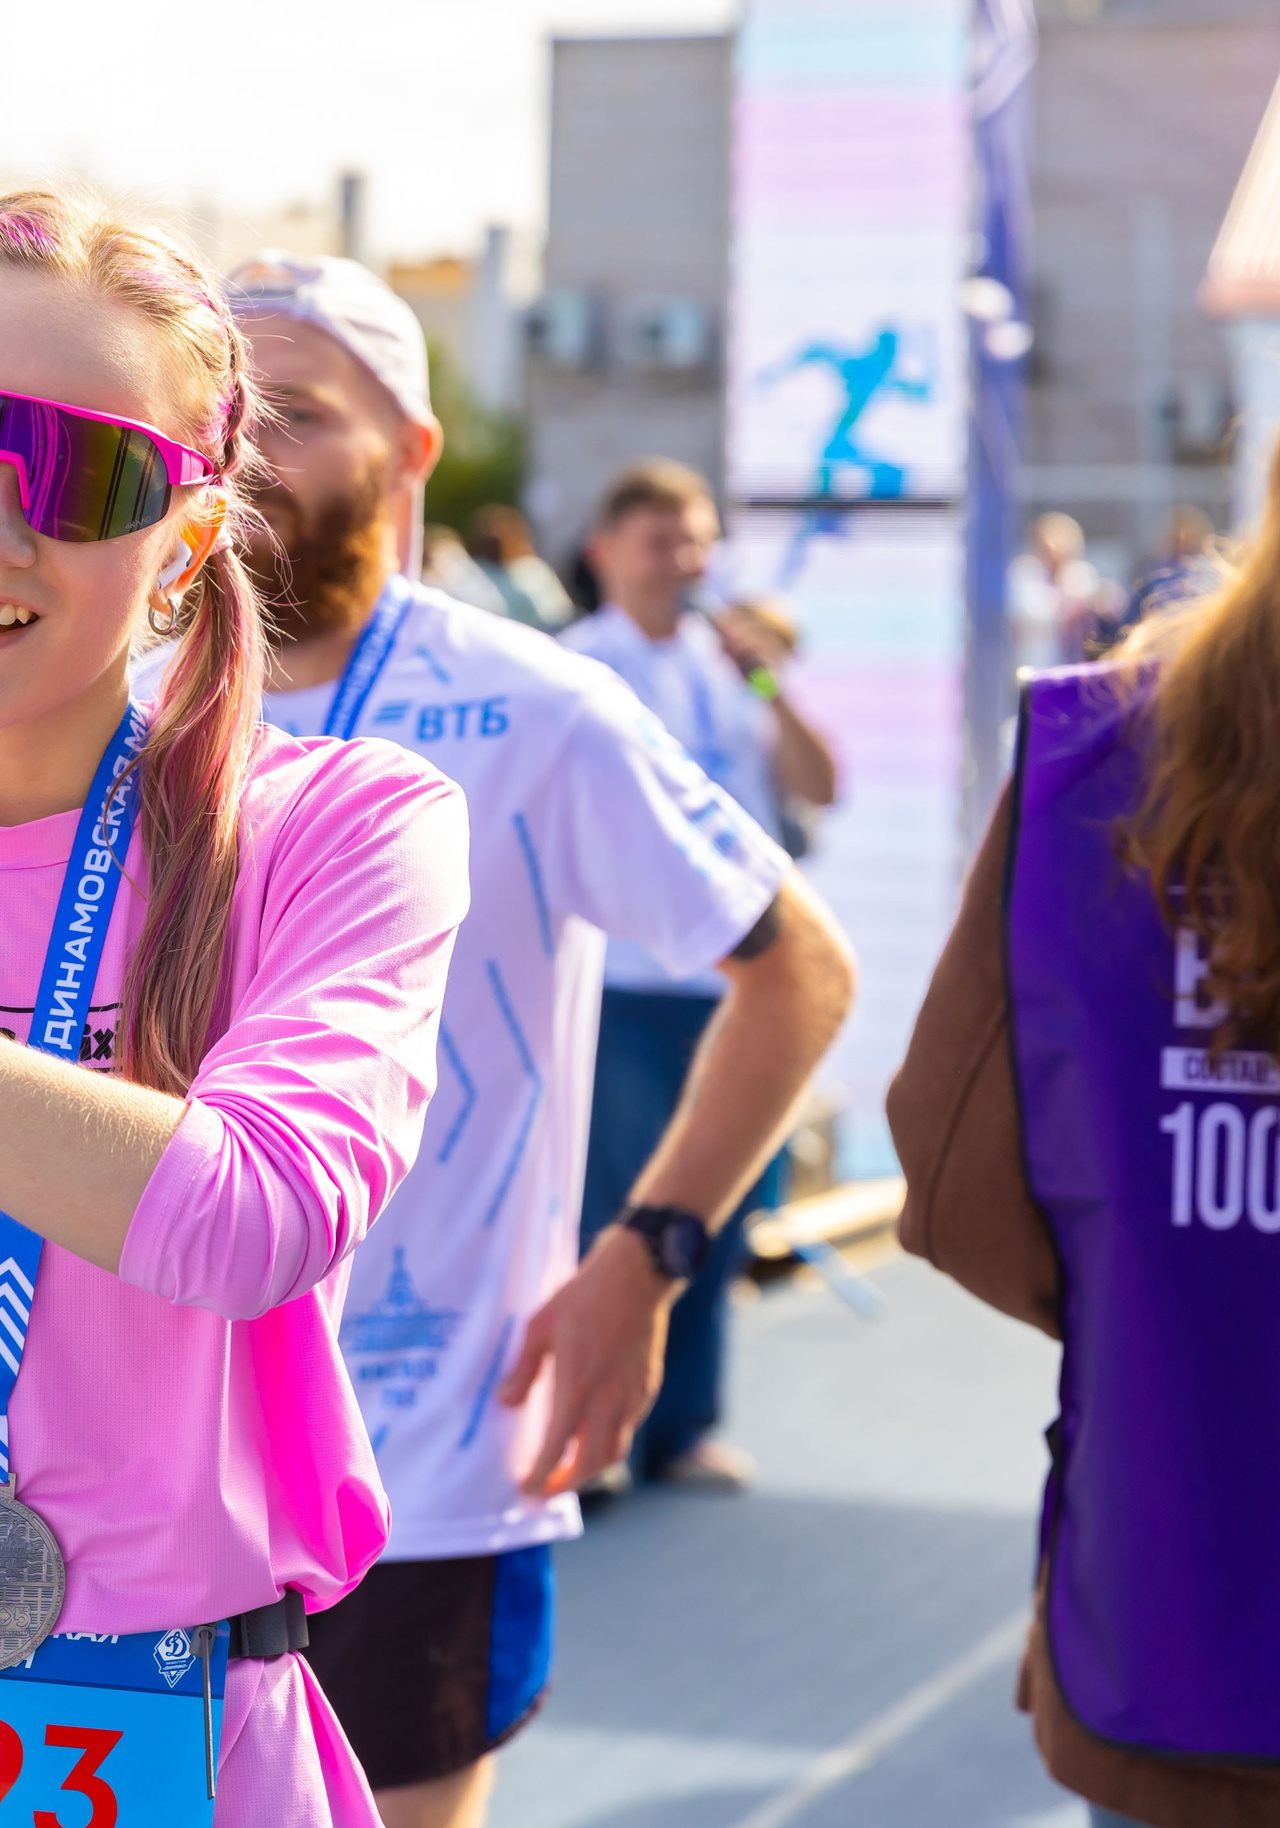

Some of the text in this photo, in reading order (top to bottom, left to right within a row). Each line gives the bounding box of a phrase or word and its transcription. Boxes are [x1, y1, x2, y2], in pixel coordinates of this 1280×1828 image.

[416, 698, 508, 742] ВТБ
[43, 754, 137, 1050] ДИНАМОВСКАЯ
[1159, 1102, 1280, 1233] 100
